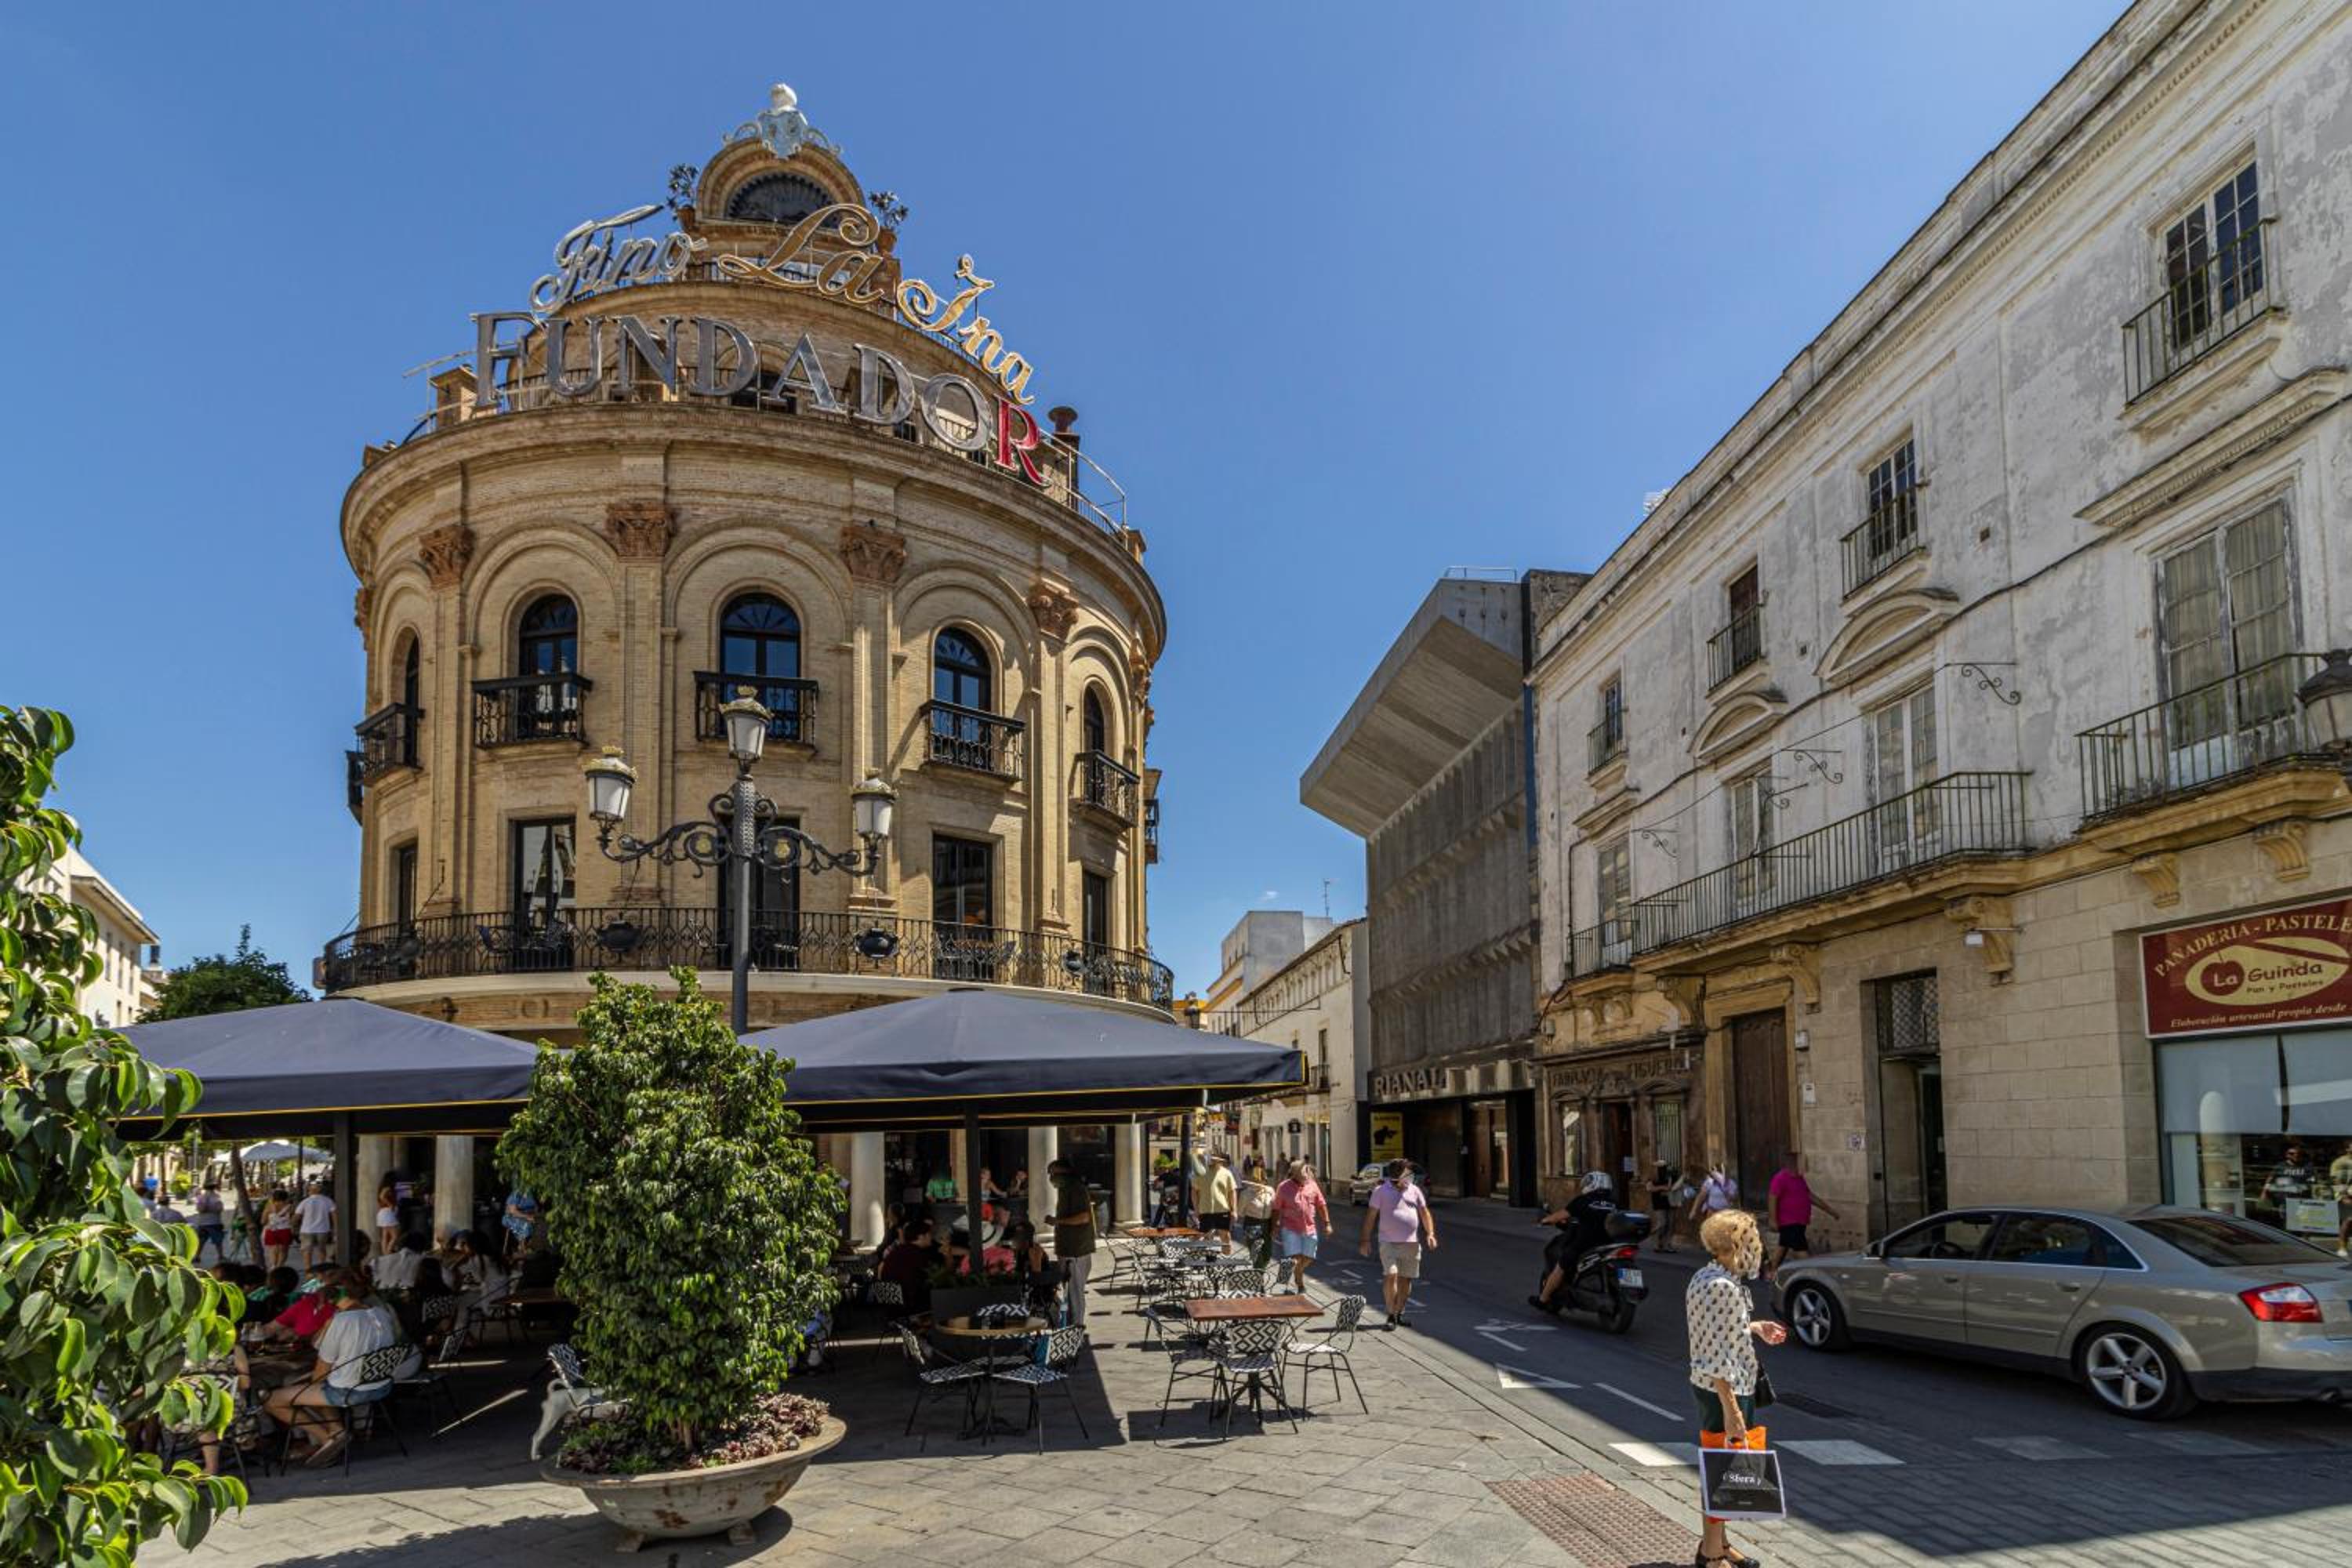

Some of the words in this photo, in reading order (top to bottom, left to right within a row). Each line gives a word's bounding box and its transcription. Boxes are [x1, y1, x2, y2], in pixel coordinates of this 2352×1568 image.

[529, 204, 707, 314] Fino
[717, 202, 884, 306] La
[896, 254, 1036, 405] Ina
[469, 312, 1051, 488] FUNDADOR
[2213, 972, 2238, 987] La
[2247, 960, 2323, 982] Guinda
